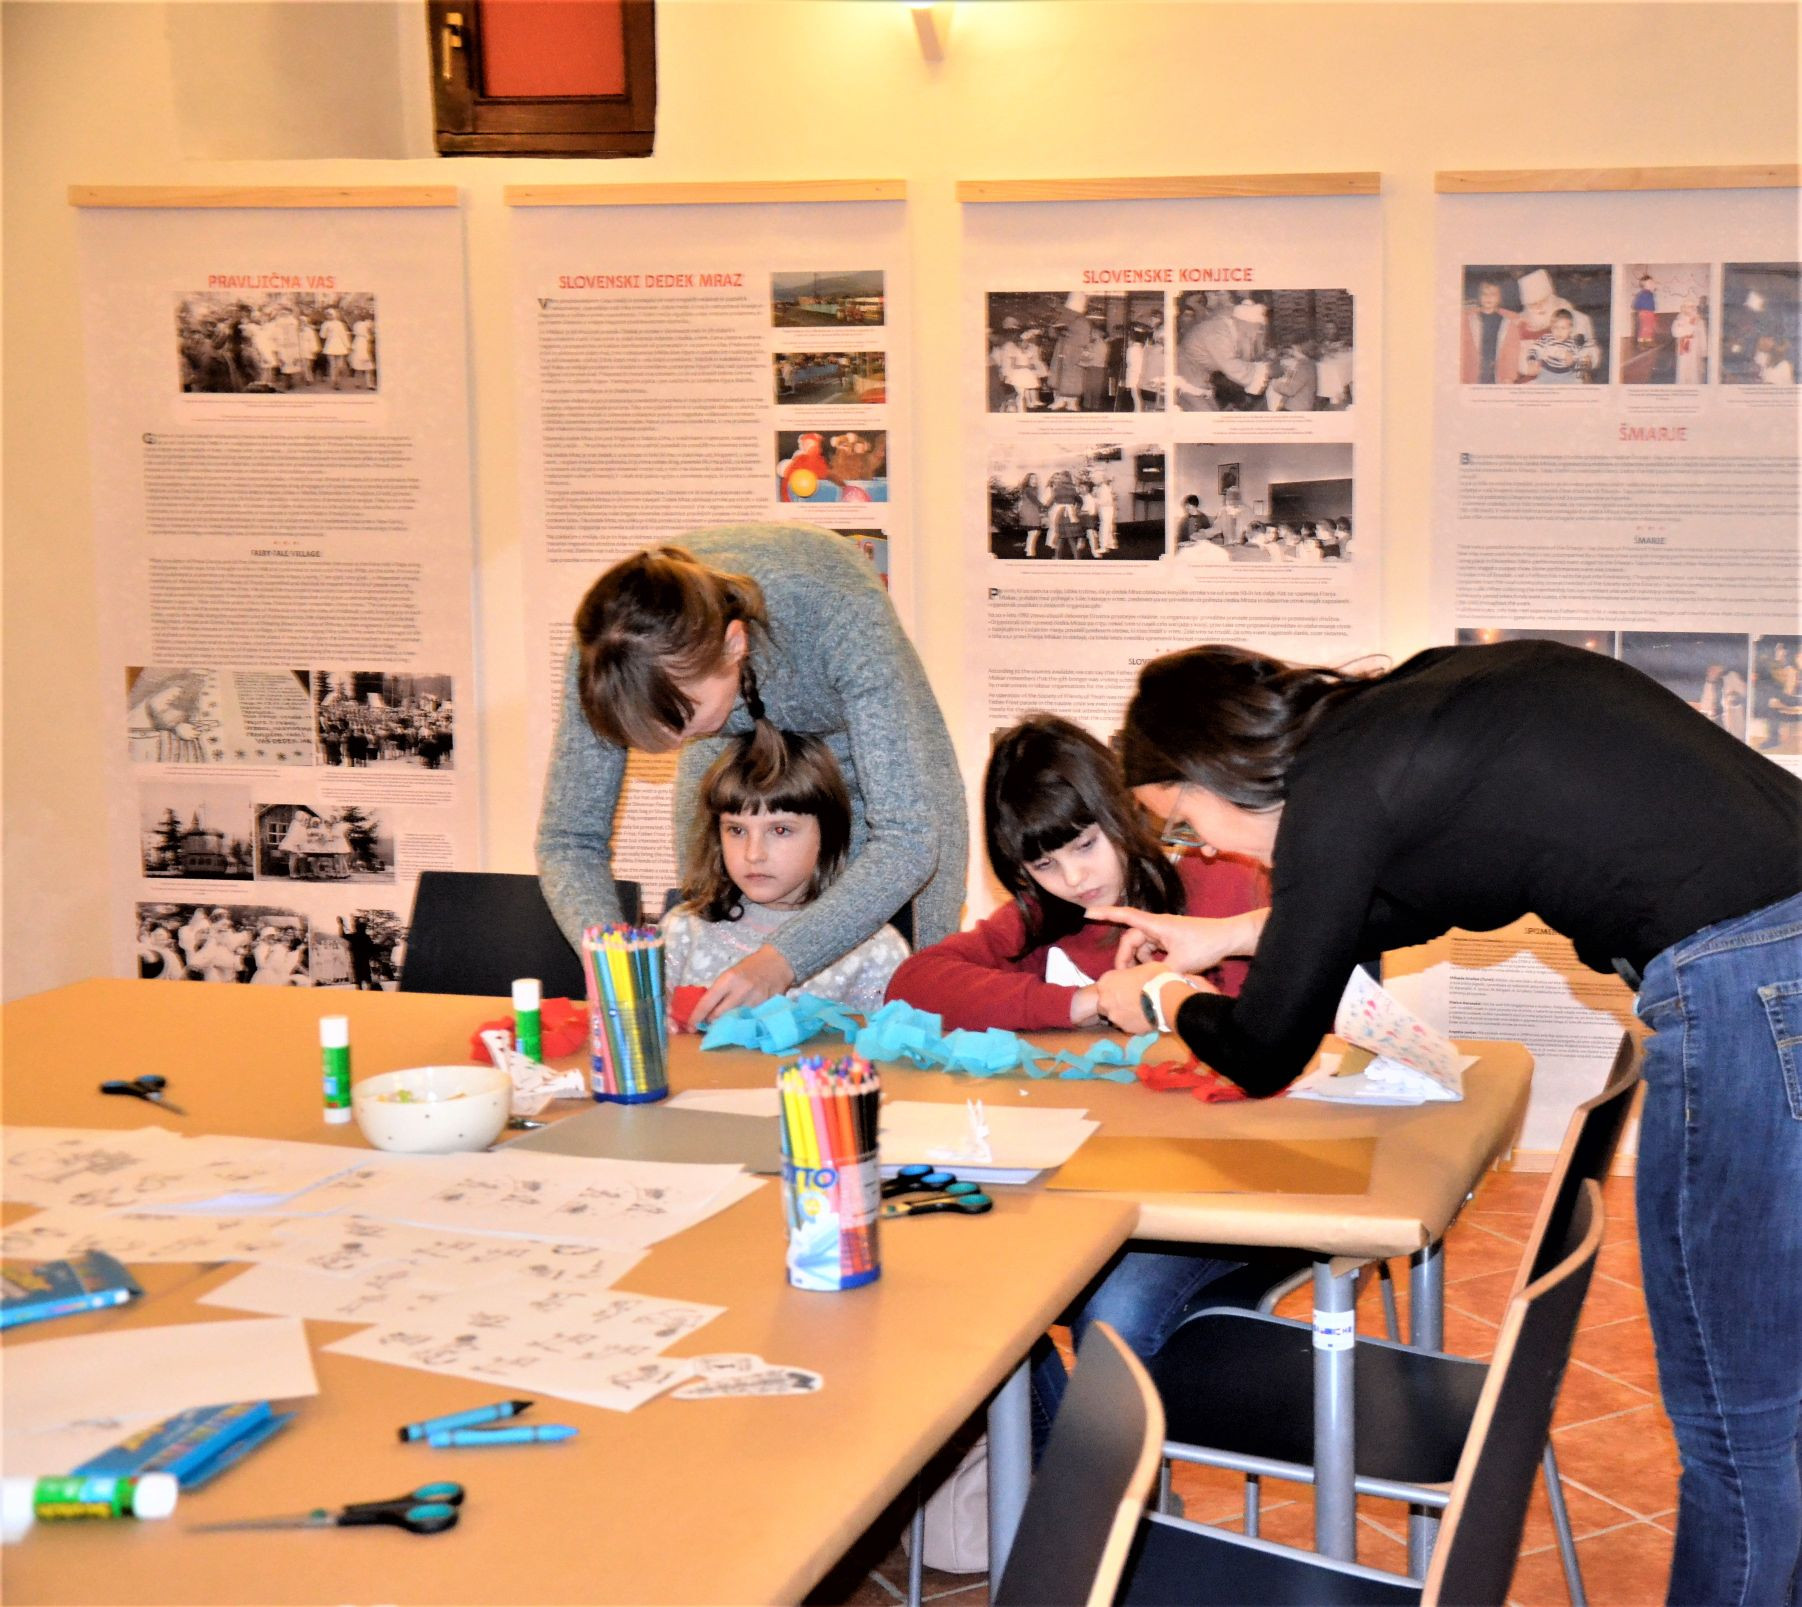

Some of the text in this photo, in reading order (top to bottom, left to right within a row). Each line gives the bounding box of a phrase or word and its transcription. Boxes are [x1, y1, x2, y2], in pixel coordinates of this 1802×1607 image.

[208, 272, 336, 289] PRAVLJIČNA VAS
[559, 273, 743, 290] SLOVENSKI DEDEK MRAZ
[1083, 268, 1254, 284] SLOVENSKE KONJICE
[1618, 422, 1688, 442] ŠMARJE
